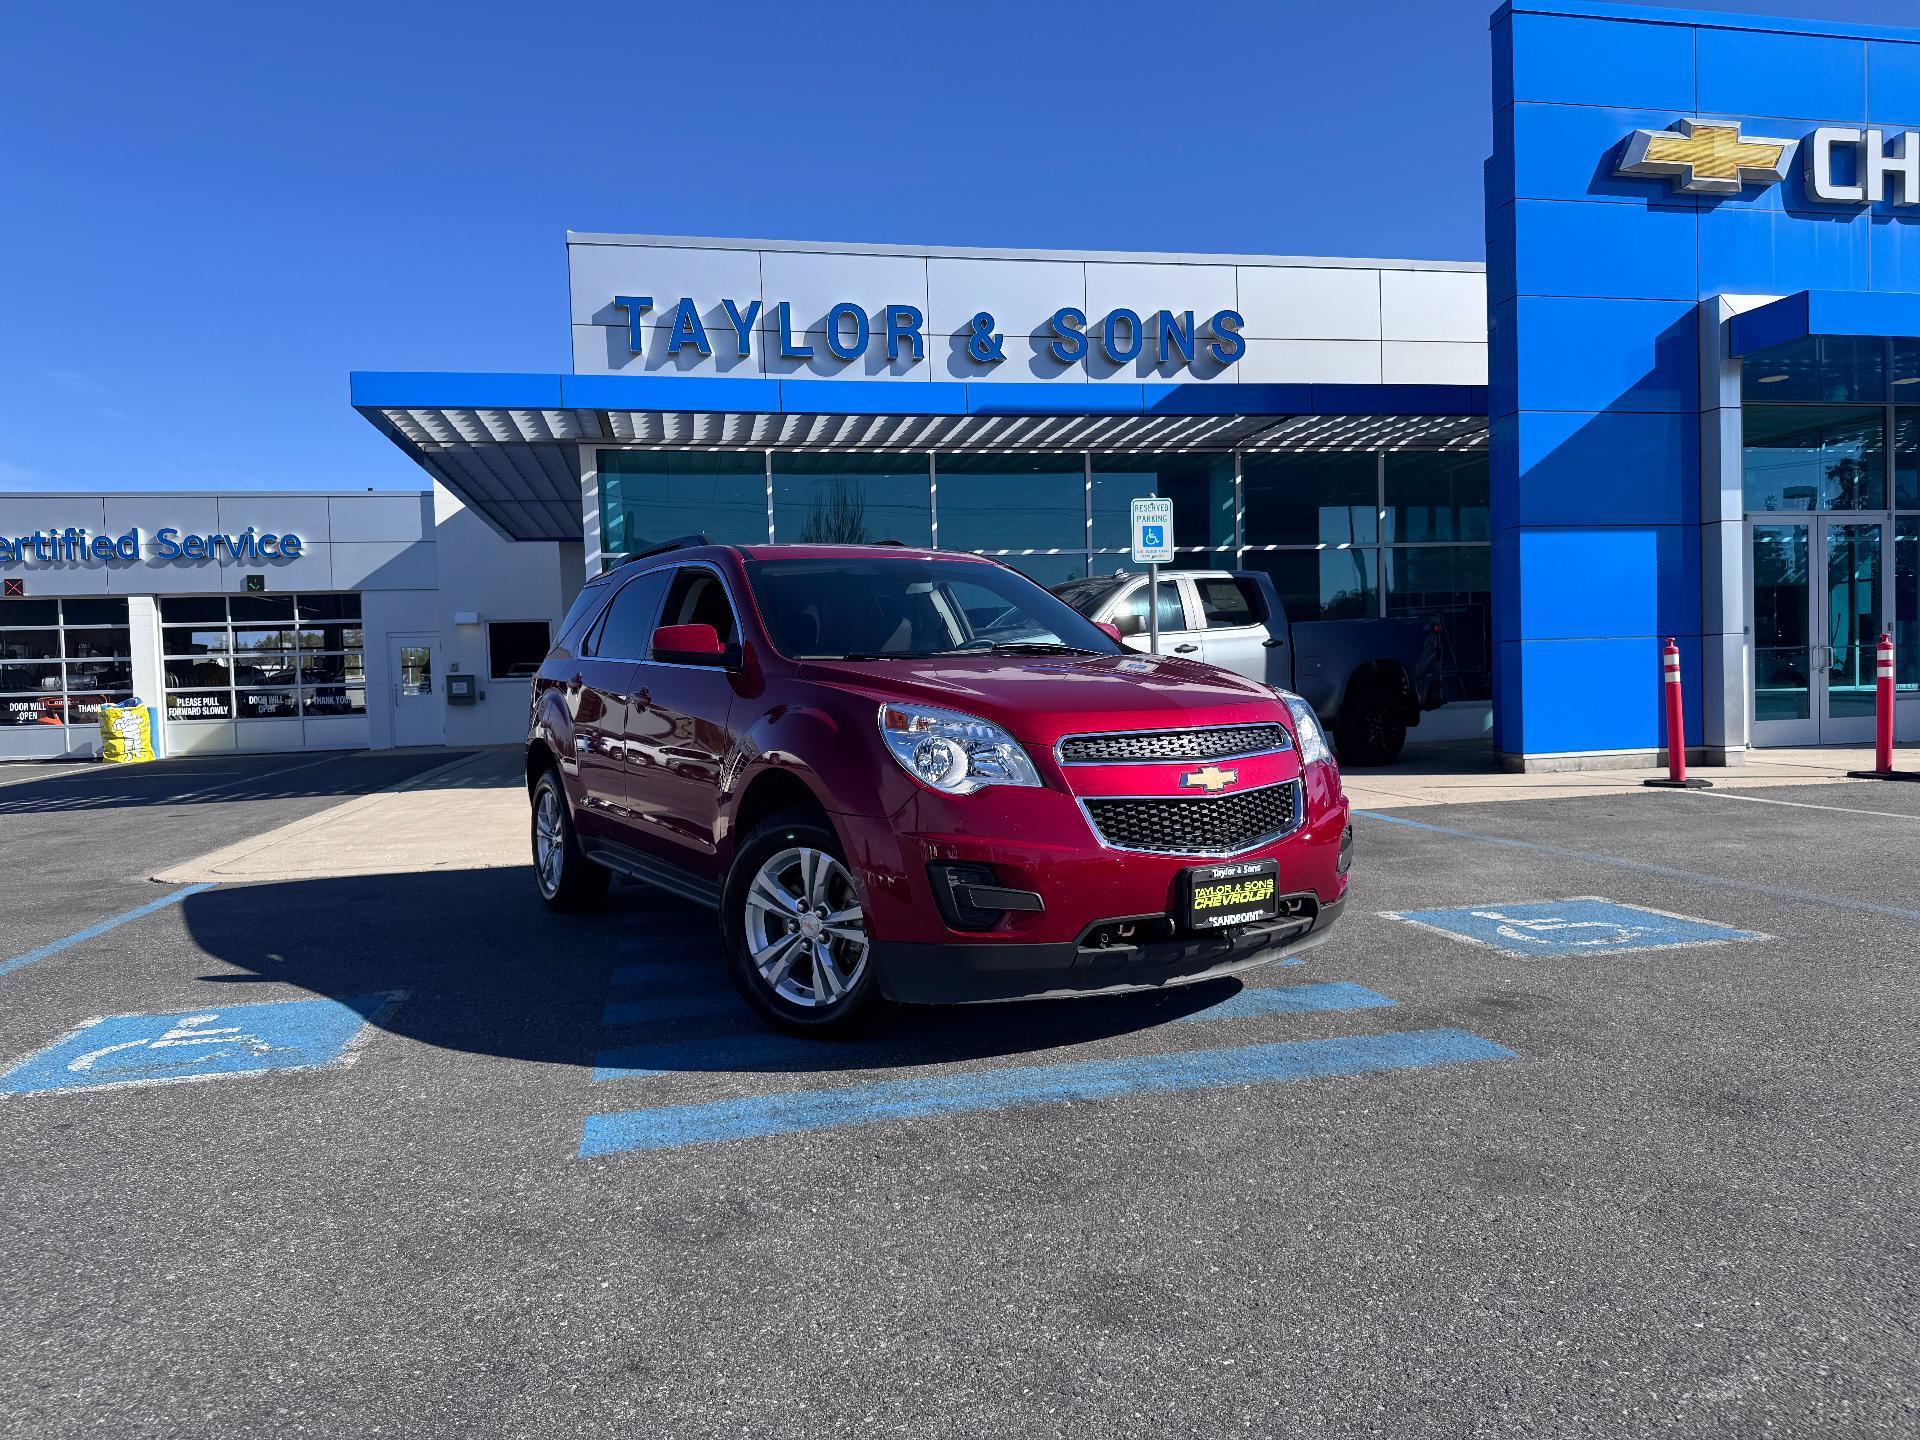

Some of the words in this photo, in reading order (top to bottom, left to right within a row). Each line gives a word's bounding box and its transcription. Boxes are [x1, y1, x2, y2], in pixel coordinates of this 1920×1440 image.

[1813, 127, 1920, 204] CH
[614, 296, 924, 361] TAYLOR
[968, 312, 1007, 362] &
[1051, 307, 1246, 363] SONS
[1134, 504, 1169, 512] RESERVED
[156, 527, 302, 559] Service
[177, 697, 202, 707] PLEASE
[203, 697, 219, 706] PULL
[249, 696, 267, 704] DOOR
[269, 696, 284, 704] WILL
[314, 696, 334, 705] THANK
[10, 702, 29, 711] DOOR
[30, 702, 46, 710] WILL
[168, 707, 201, 716] FORWARD
[202, 706, 228, 715] SLOWLY
[19, 711, 38, 720] OPEN
[1213, 869, 1236, 878] Taylor
[1243, 865, 1262, 873] Sons
[1194, 885, 1232, 898] TAYLOR
[1234, 884, 1242, 893] &
[1244, 879, 1274, 891] SONS
[1194, 890, 1274, 909] CHEVROLET
[1209, 909, 1264, 927] "SANDPOINT"
